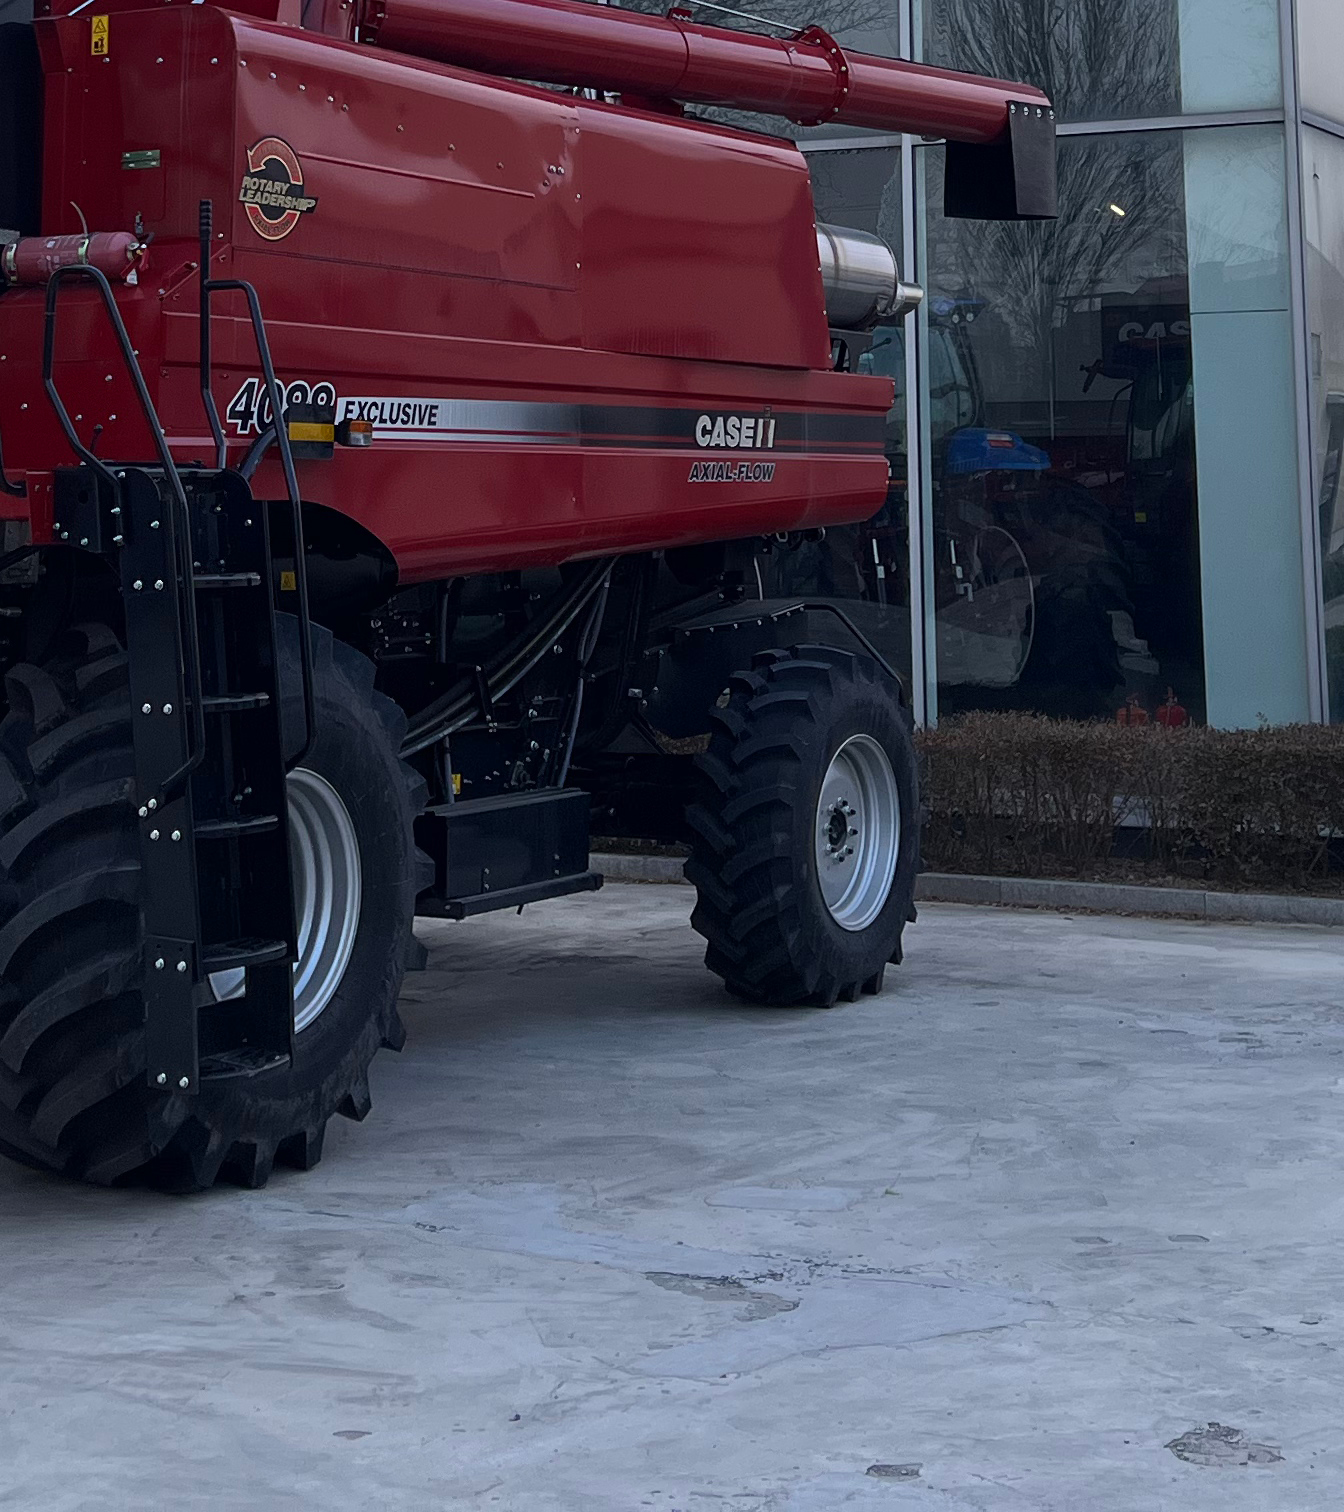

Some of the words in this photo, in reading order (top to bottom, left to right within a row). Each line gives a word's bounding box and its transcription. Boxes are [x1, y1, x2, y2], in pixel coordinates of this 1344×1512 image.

[241, 175, 291, 196] ROTARY
[238, 188, 317, 212] LEADERSHIP
[344, 400, 439, 427] EXCLUSIVE
[695, 414, 755, 448] CASE
[687, 461, 776, 483] AXIAL-FLOW
